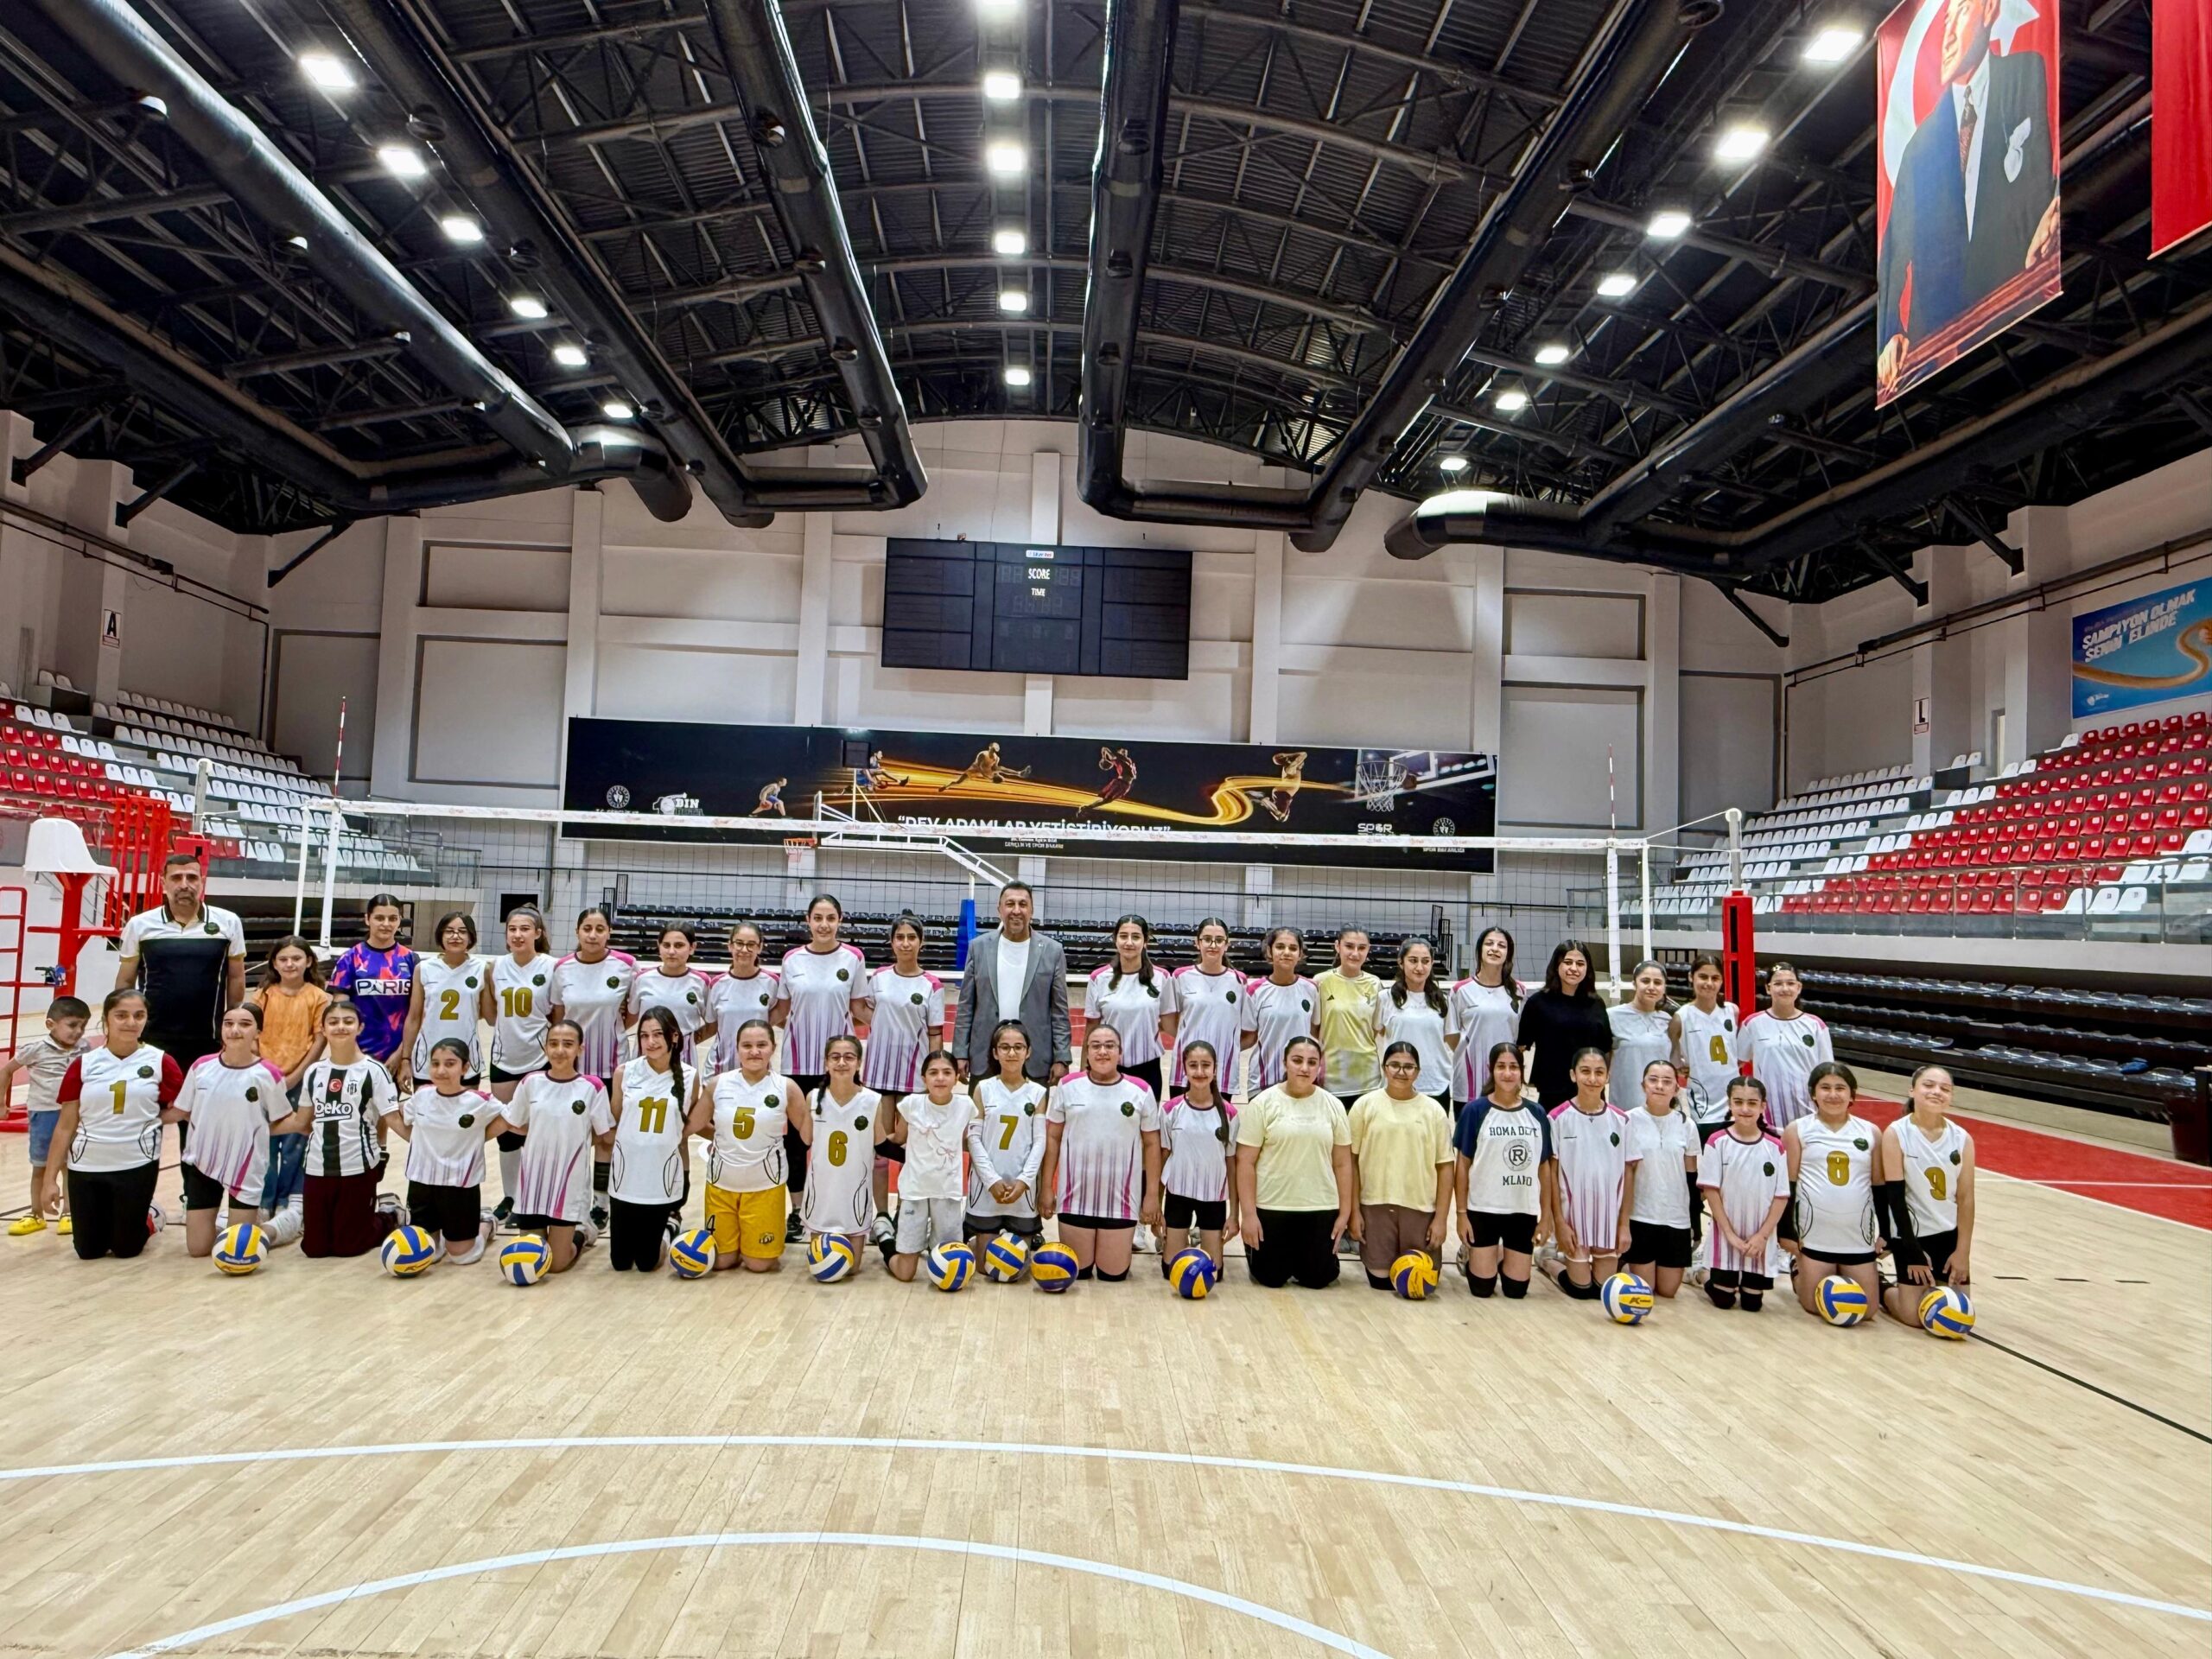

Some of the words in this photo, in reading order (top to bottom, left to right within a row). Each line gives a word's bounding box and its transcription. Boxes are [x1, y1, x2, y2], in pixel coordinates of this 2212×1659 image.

[1028, 568, 1051, 580] SCORE
[1031, 588, 1046, 597] TIME
[106, 612, 118, 638] A
[1918, 700, 1926, 723] L
[357, 980, 410, 995] PARIS
[440, 989, 460, 1020] 2
[500, 988, 533, 1018] 10
[1710, 1035, 1728, 1065] 4
[109, 1081, 126, 1115] 1
[315, 1100, 353, 1115] beko
[639, 1096, 668, 1134] 11
[732, 1107, 755, 1140] 5
[1000, 1115, 1019, 1150] 7
[1489, 1126, 1516, 1136] ROMA
[828, 1130, 849, 1167] 6
[1512, 1148, 1524, 1161] R
[1826, 1150, 1850, 1186] 8
[1924, 1166, 1947, 1201] 9
[707, 1214, 715, 1234] 4
